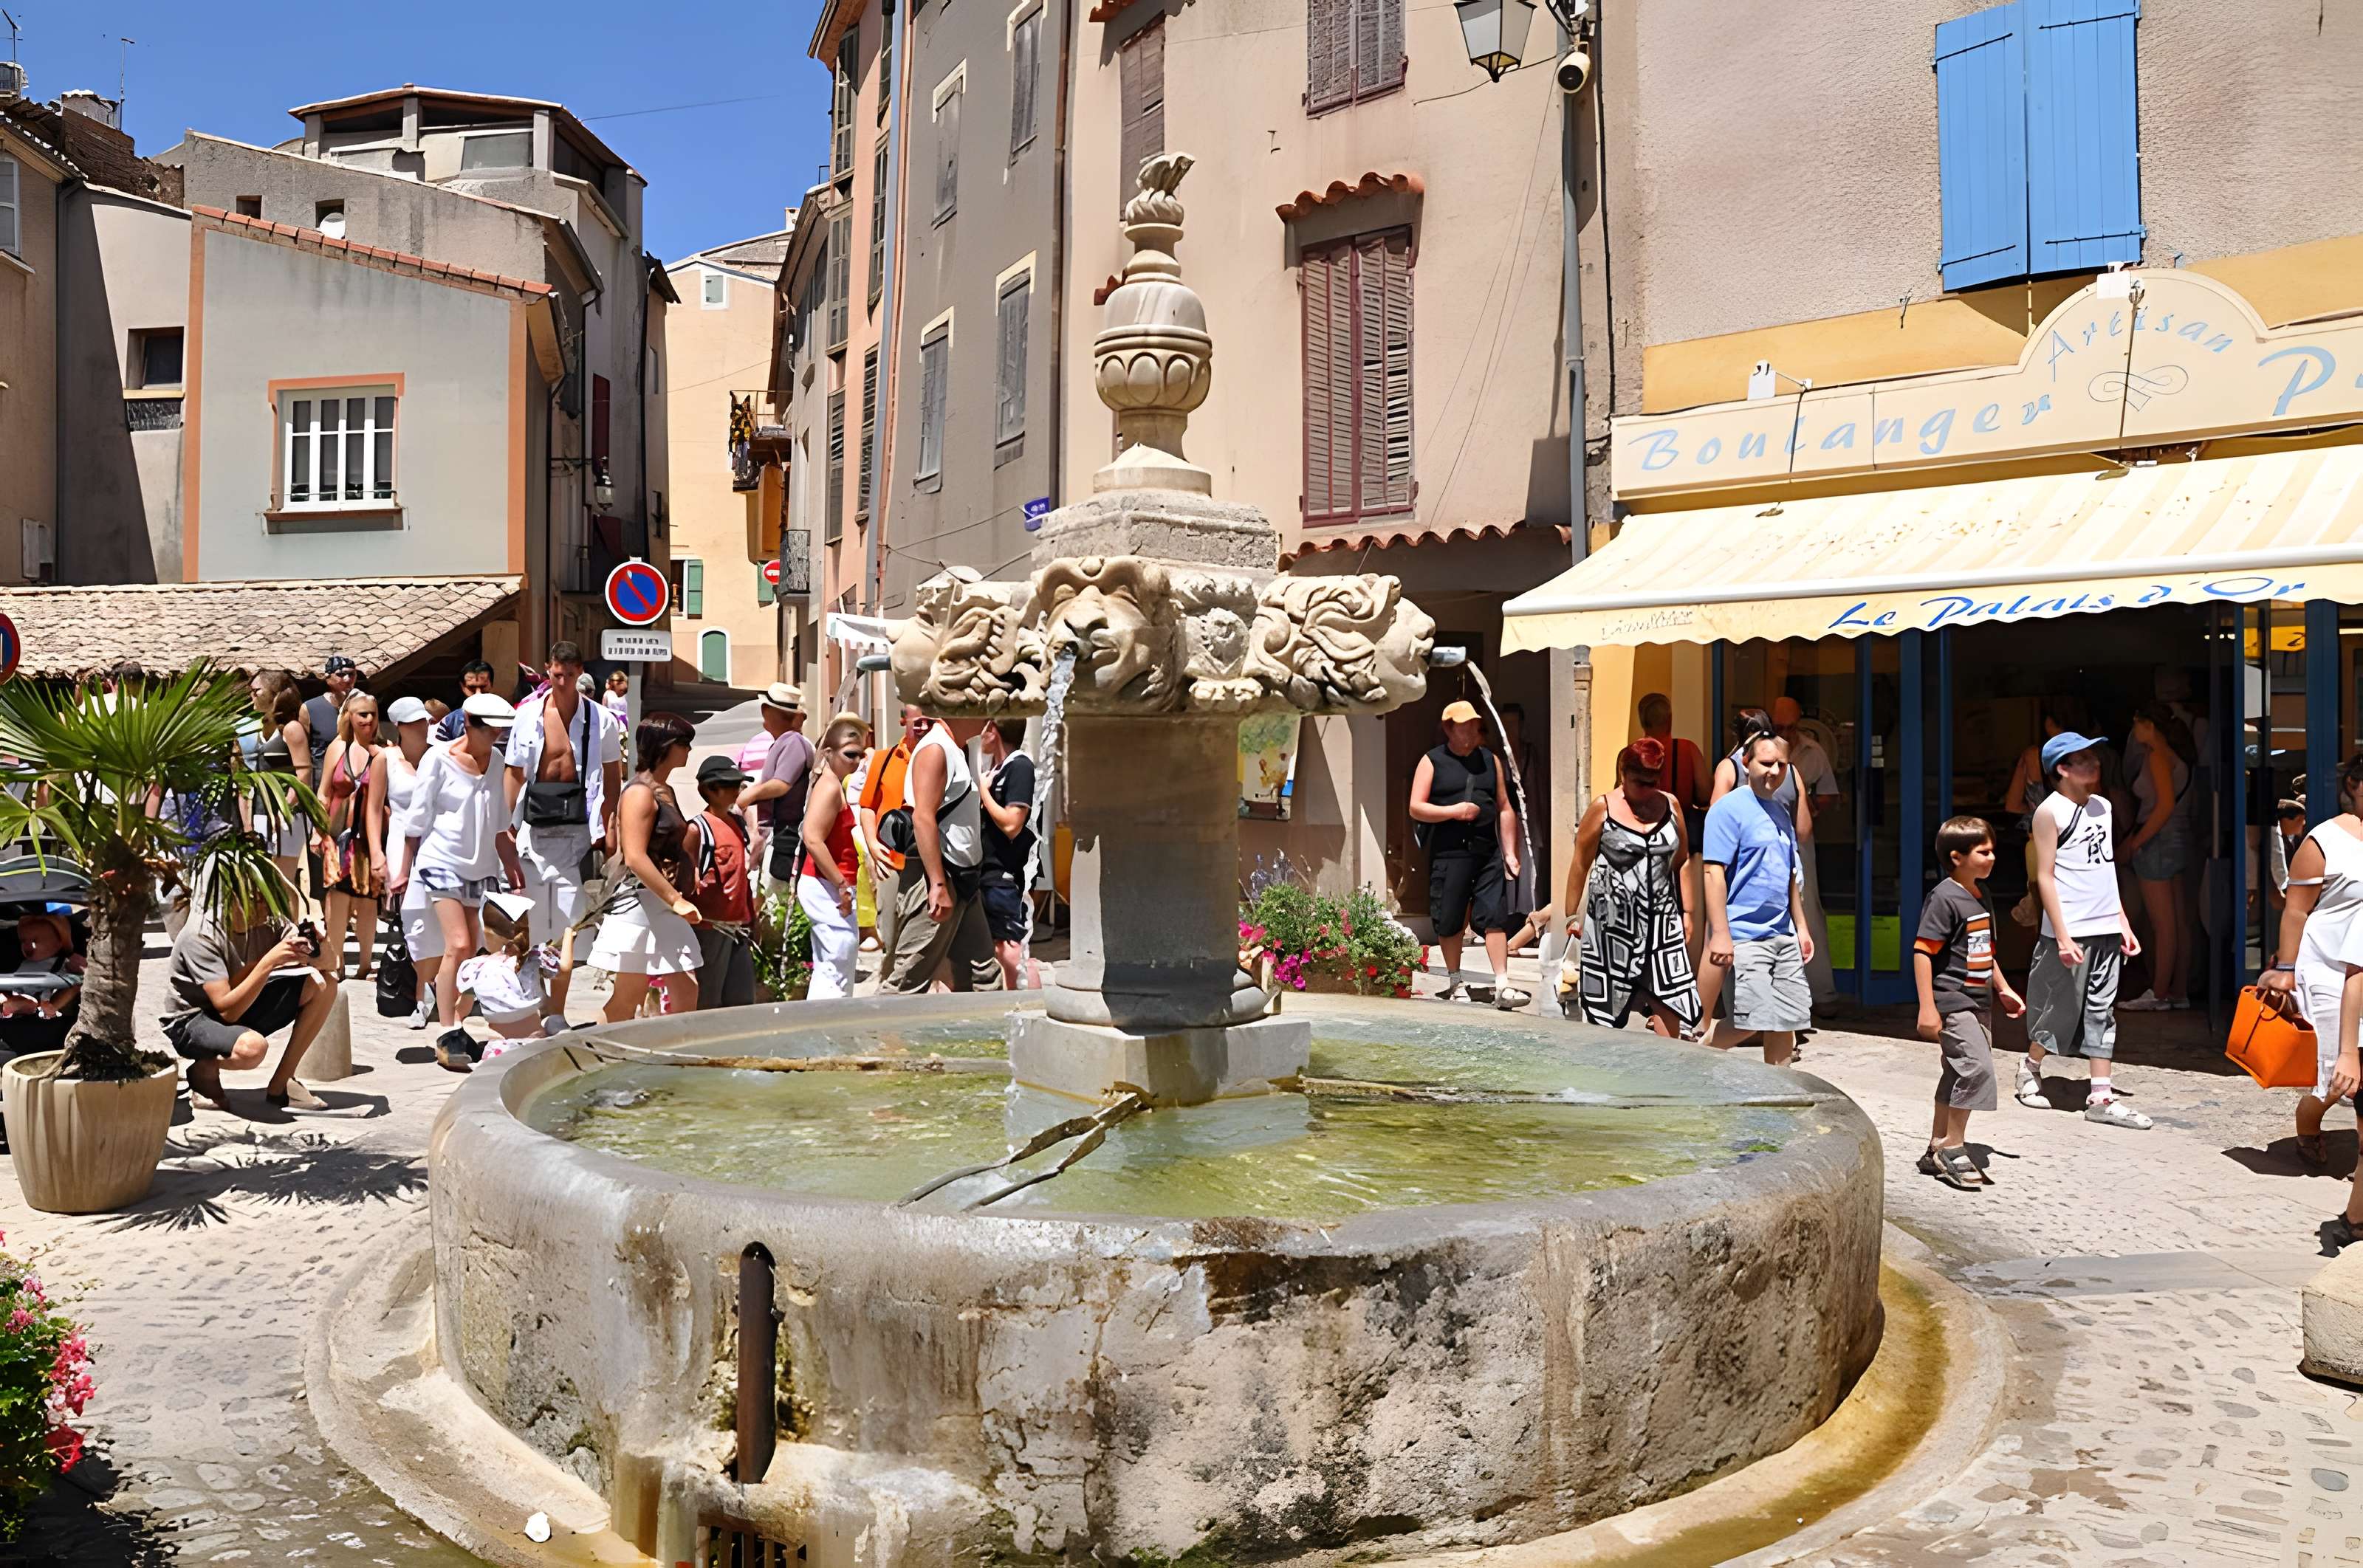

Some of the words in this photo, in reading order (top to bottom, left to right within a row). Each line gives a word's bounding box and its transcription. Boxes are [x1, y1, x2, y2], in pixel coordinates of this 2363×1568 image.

[2048, 306, 2234, 382] Artisan
[1628, 394, 2051, 471] Boulanger
[2258, 345, 2363, 416] P
[1828, 602, 1896, 628] Le
[1920, 596, 2114, 627] Palais
